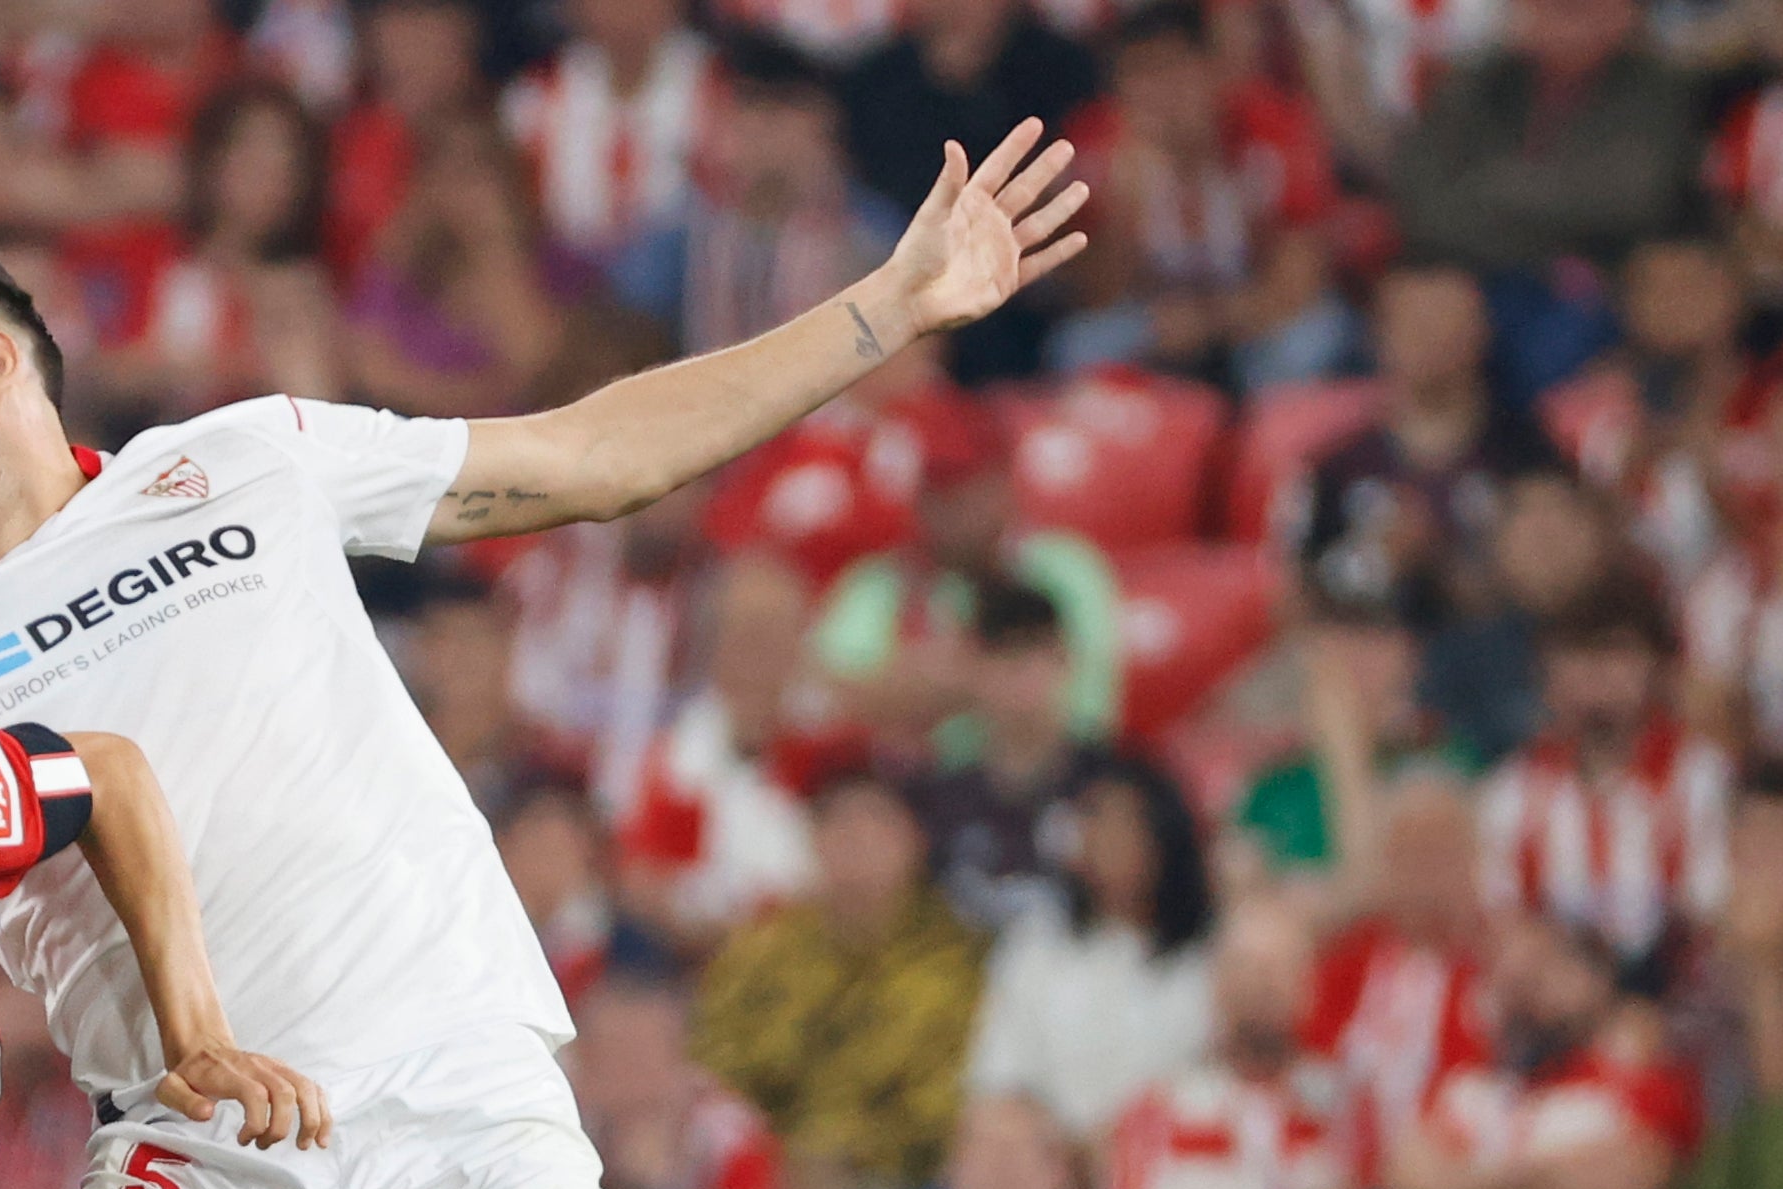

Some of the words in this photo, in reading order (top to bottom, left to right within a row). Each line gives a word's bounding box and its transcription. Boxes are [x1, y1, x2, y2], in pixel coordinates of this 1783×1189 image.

[25, 524, 256, 651] DEGIRO
[93, 604, 181, 660] LEADING
[185, 574, 267, 610] BROKER
